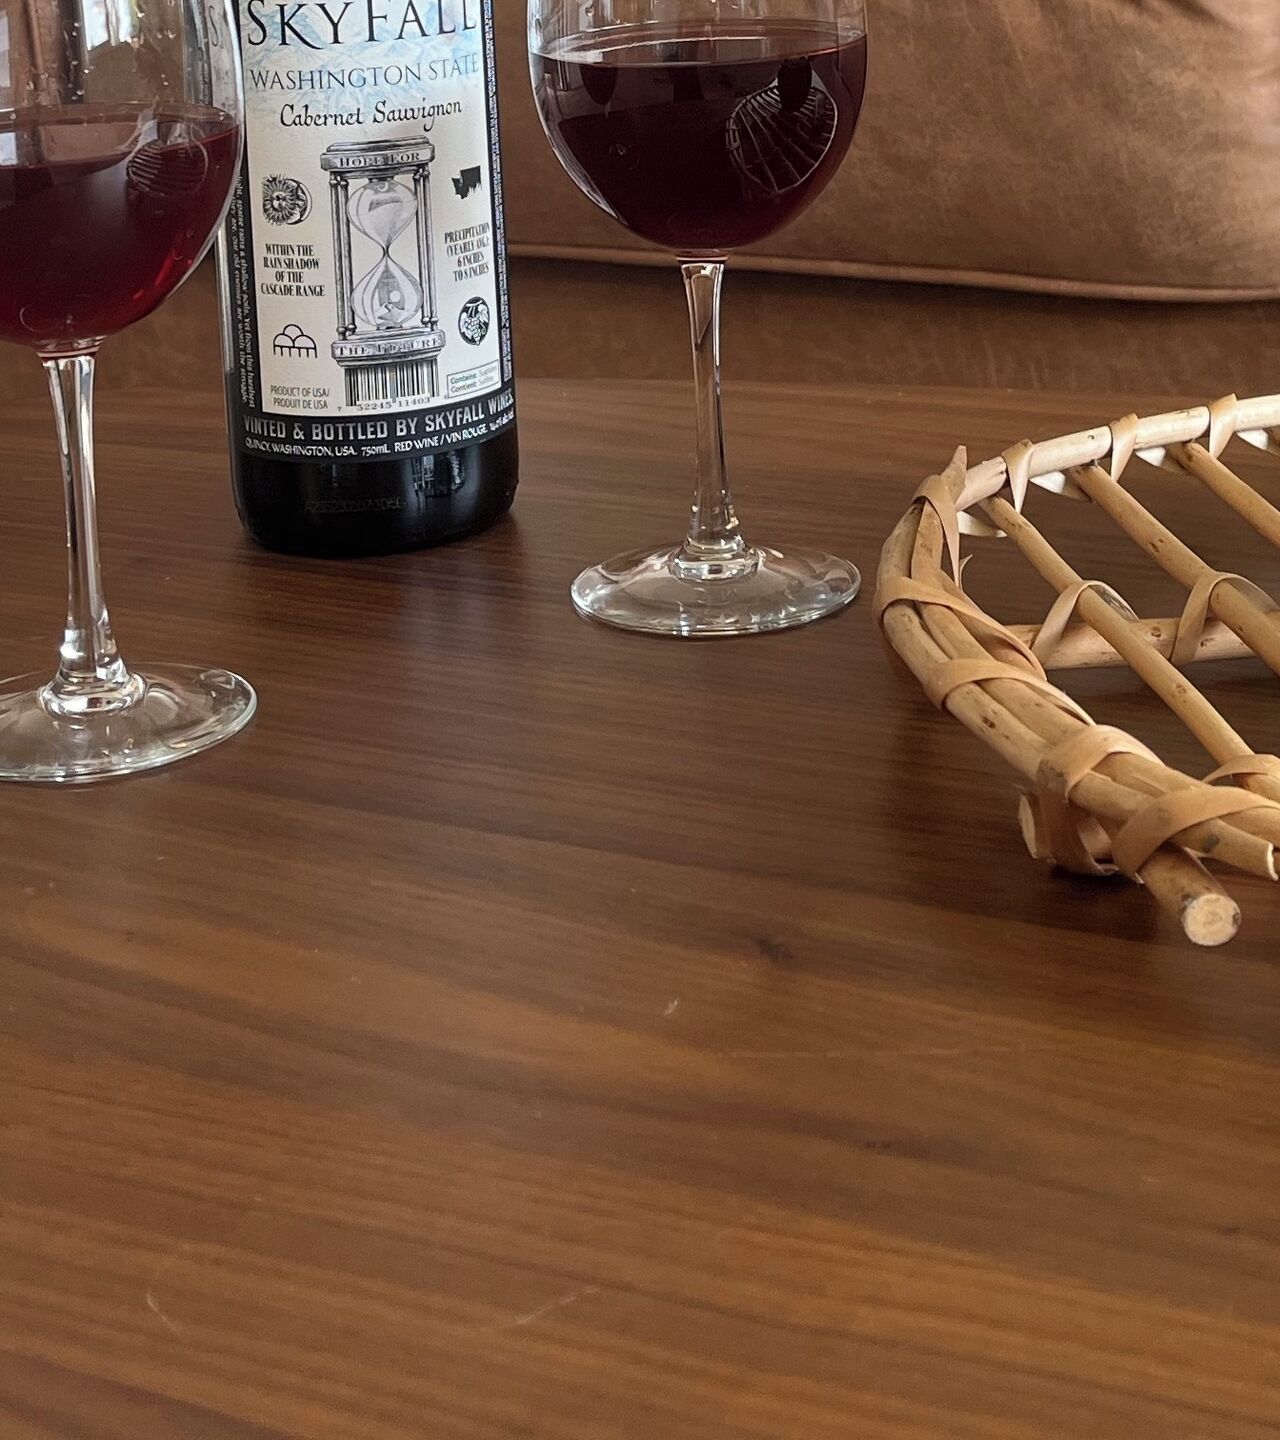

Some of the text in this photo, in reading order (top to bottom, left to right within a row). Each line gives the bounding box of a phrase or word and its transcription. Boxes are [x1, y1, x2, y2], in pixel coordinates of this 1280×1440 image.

[249, 53, 480, 91] WASHINGTON STATE
[279, 96, 463, 132] Cabernet Sauvignon
[265, 243, 314, 257] WITHIN THE
[263, 256, 320, 270] RAIN SHADOW
[275, 270, 304, 283] OF THE
[453, 270, 463, 282] TO
[260, 282, 326, 297] CASCADE RANGE
[270, 384, 300, 397] PRODUCT
[302, 387, 311, 397] OF
[273, 397, 328, 410] PRODUIT DE USA
[243, 415, 286, 438] VINTED
[292, 423, 305, 440] &
[311, 421, 388, 440] BOTTLED
[395, 417, 418, 437] BY
[424, 402, 485, 432] SKYFALL
[394, 440, 413, 452] RED
[414, 436, 439, 449] WINE
[445, 432, 462, 444] VIN
[462, 423, 488, 440] ROUGE
